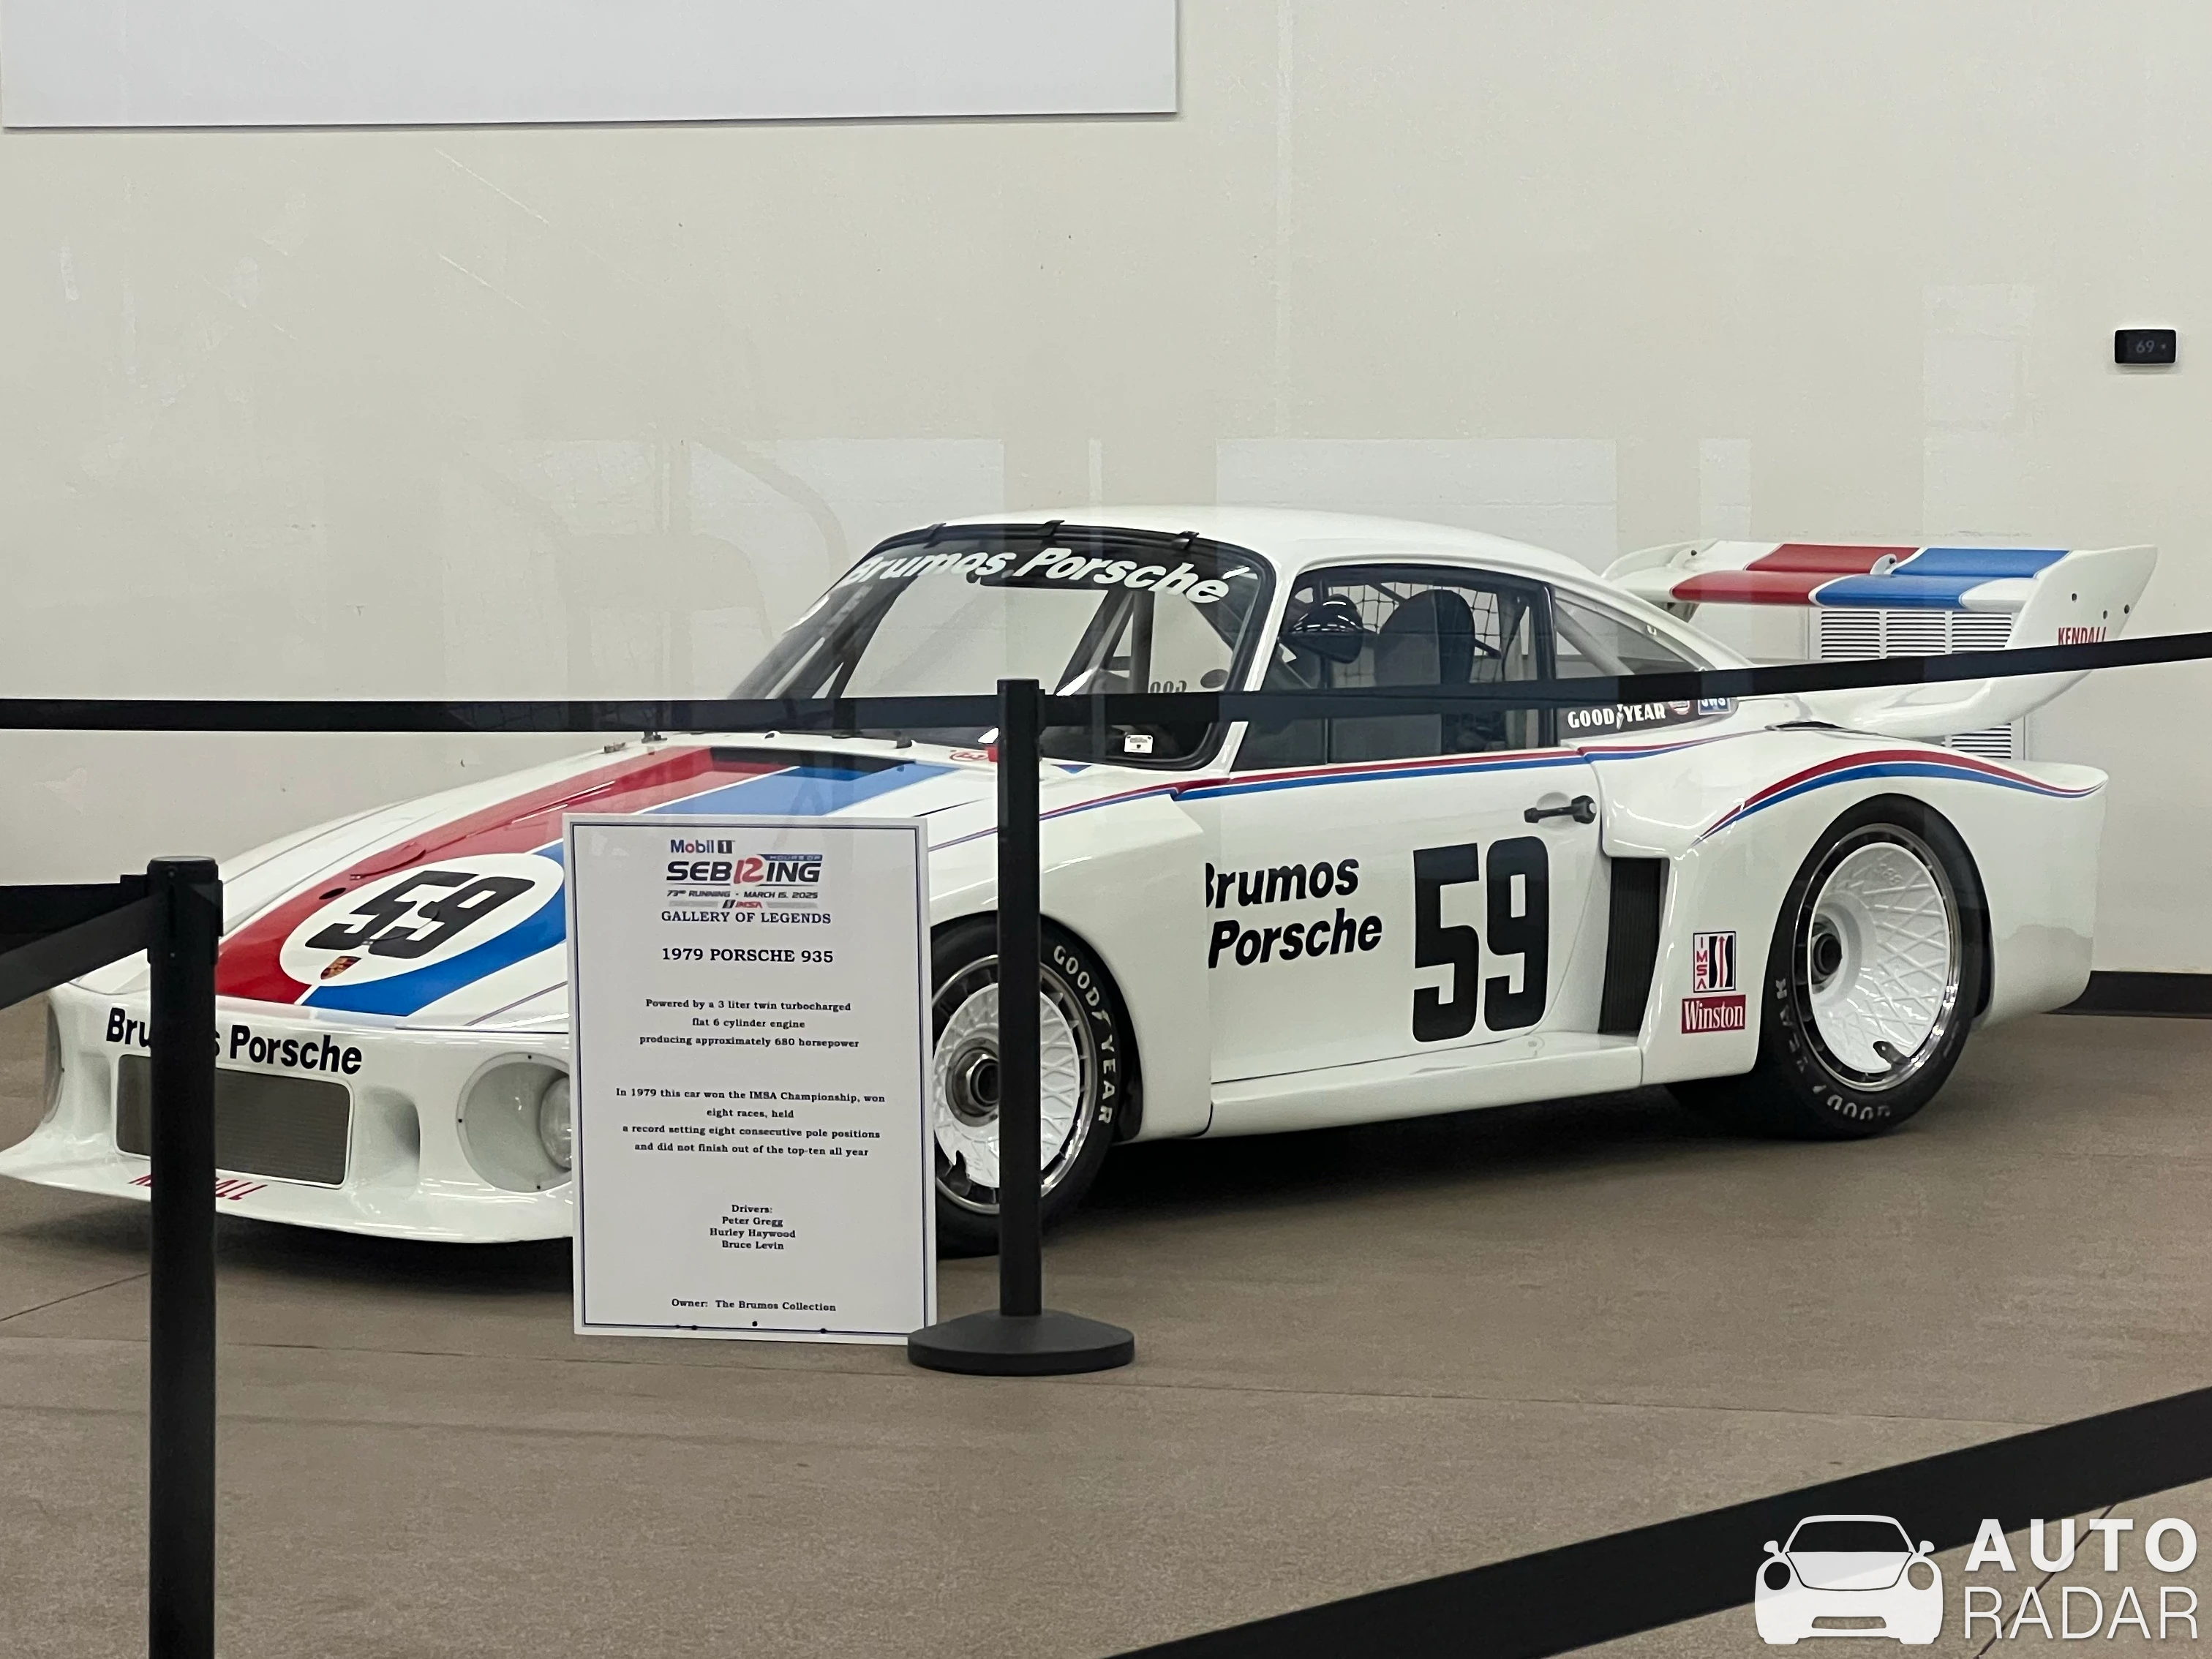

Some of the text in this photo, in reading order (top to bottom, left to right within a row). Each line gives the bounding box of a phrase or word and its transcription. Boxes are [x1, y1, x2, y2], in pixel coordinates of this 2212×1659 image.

[2136, 339, 2155, 354] 69
[843, 547, 1229, 604] Brumos Porsche
[670, 839, 714, 854] Mobil
[305, 870, 536, 960] 59
[661, 911, 832, 925] GALLERY OF LEGENDS
[1208, 907, 1382, 969] Porsche
[1412, 835, 1549, 1043] 59
[662, 947, 834, 963] 1979 PORSCHE 935
[1696, 936, 1708, 990] IMSA
[645, 998, 690, 1008] Powered
[692, 999, 706, 1010] by
[718, 1000, 725, 1009] 3
[728, 1000, 750, 1009] liter
[753, 1001, 778, 1010] twin
[780, 1001, 851, 1013] turbocharged
[1684, 1000, 1744, 1031] Winston
[692, 1017, 805, 1030] flat 6 cylinder engine
[106, 1007, 363, 1075] Bru Porsche
[639, 1035, 859, 1049] producing approximately 680 horsepower
[616, 1088, 627, 1096] In
[631, 1088, 657, 1097] 1979
[660, 1088, 681, 1098] this
[728, 1090, 746, 1099] the
[749, 1091, 778, 1100] IMSA
[780, 1091, 861, 1104] Championship,
[706, 1107, 794, 1119] eight races, held
[631, 1125, 666, 1133] record
[669, 1126, 706, 1136] setting
[708, 1126, 736, 1137] eight
[739, 1128, 802, 1137] consecutive
[805, 1129, 828, 1139] pole
[831, 1129, 881, 1140] positions
[634, 1142, 654, 1151] and
[657, 1142, 674, 1151] did
[677, 1143, 696, 1152] not
[698, 1143, 729, 1153] finish
[753, 1146, 764, 1154] of
[766, 1145, 784, 1154] the
[787, 1146, 826, 1157] top-ten
[829, 1147, 843, 1156] all
[845, 1149, 869, 1157] year
[731, 1204, 773, 1214] Drivers:
[721, 1216, 783, 1227] Peter Gregg
[709, 1227, 796, 1239] Hurley Haywood
[721, 1240, 785, 1250] Bruce Levin
[671, 1298, 837, 1312] Owner: The Brumos Collection
